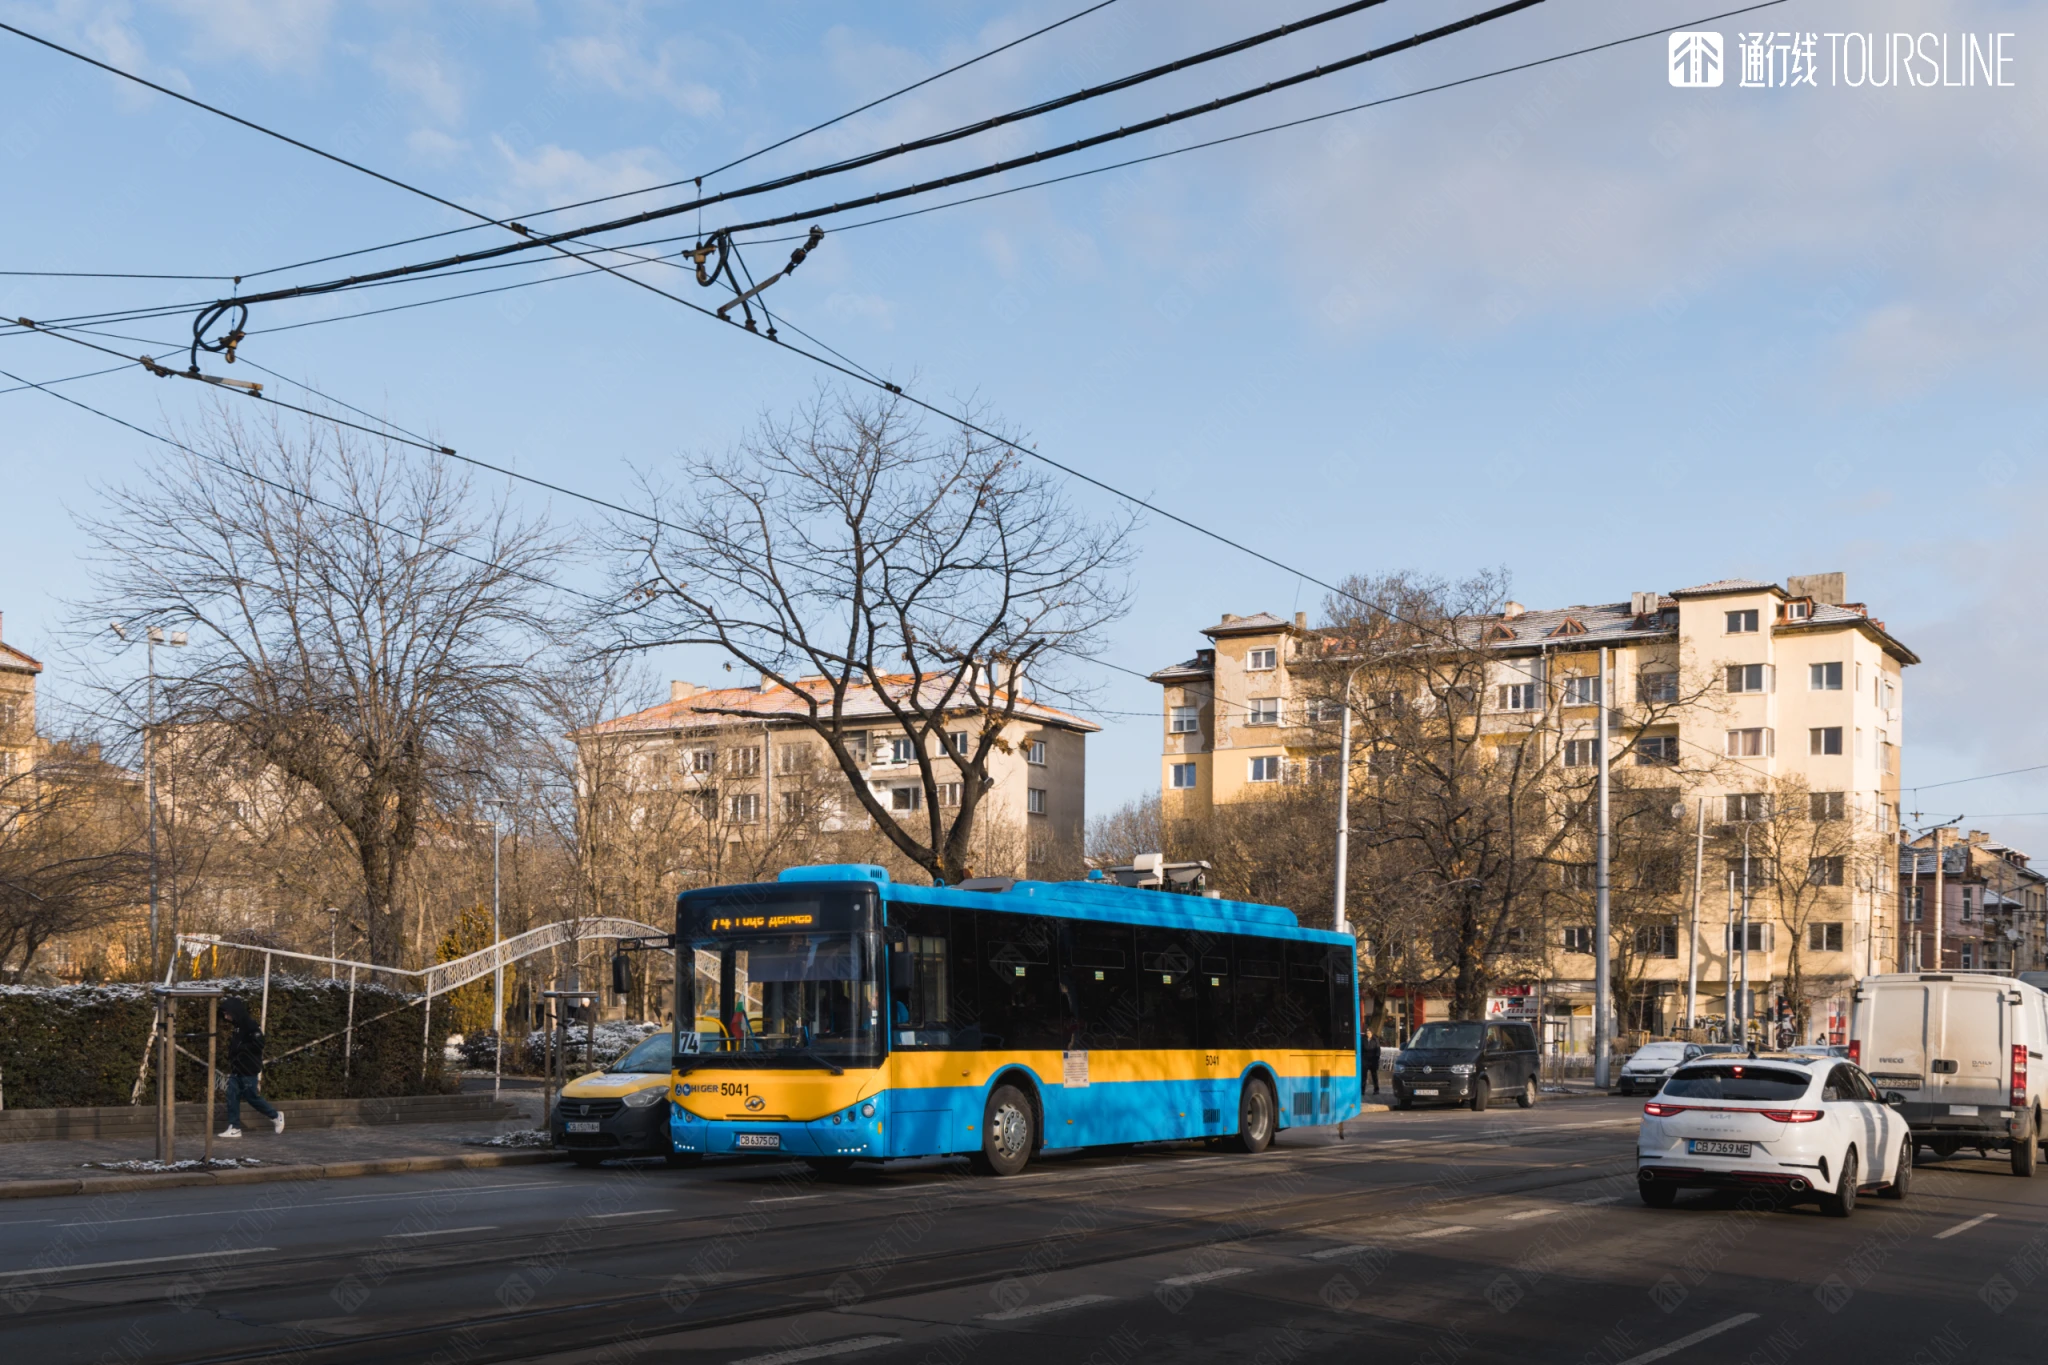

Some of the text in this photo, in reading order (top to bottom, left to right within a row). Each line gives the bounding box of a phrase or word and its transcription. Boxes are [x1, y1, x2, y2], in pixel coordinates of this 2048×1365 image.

[680, 1033, 699, 1053] 74
[1205, 1055, 1220, 1066] 5041
[691, 1084, 719, 1093] HIGER
[720, 1083, 750, 1096] 5041
[1711, 1142, 1734, 1153] 7369
